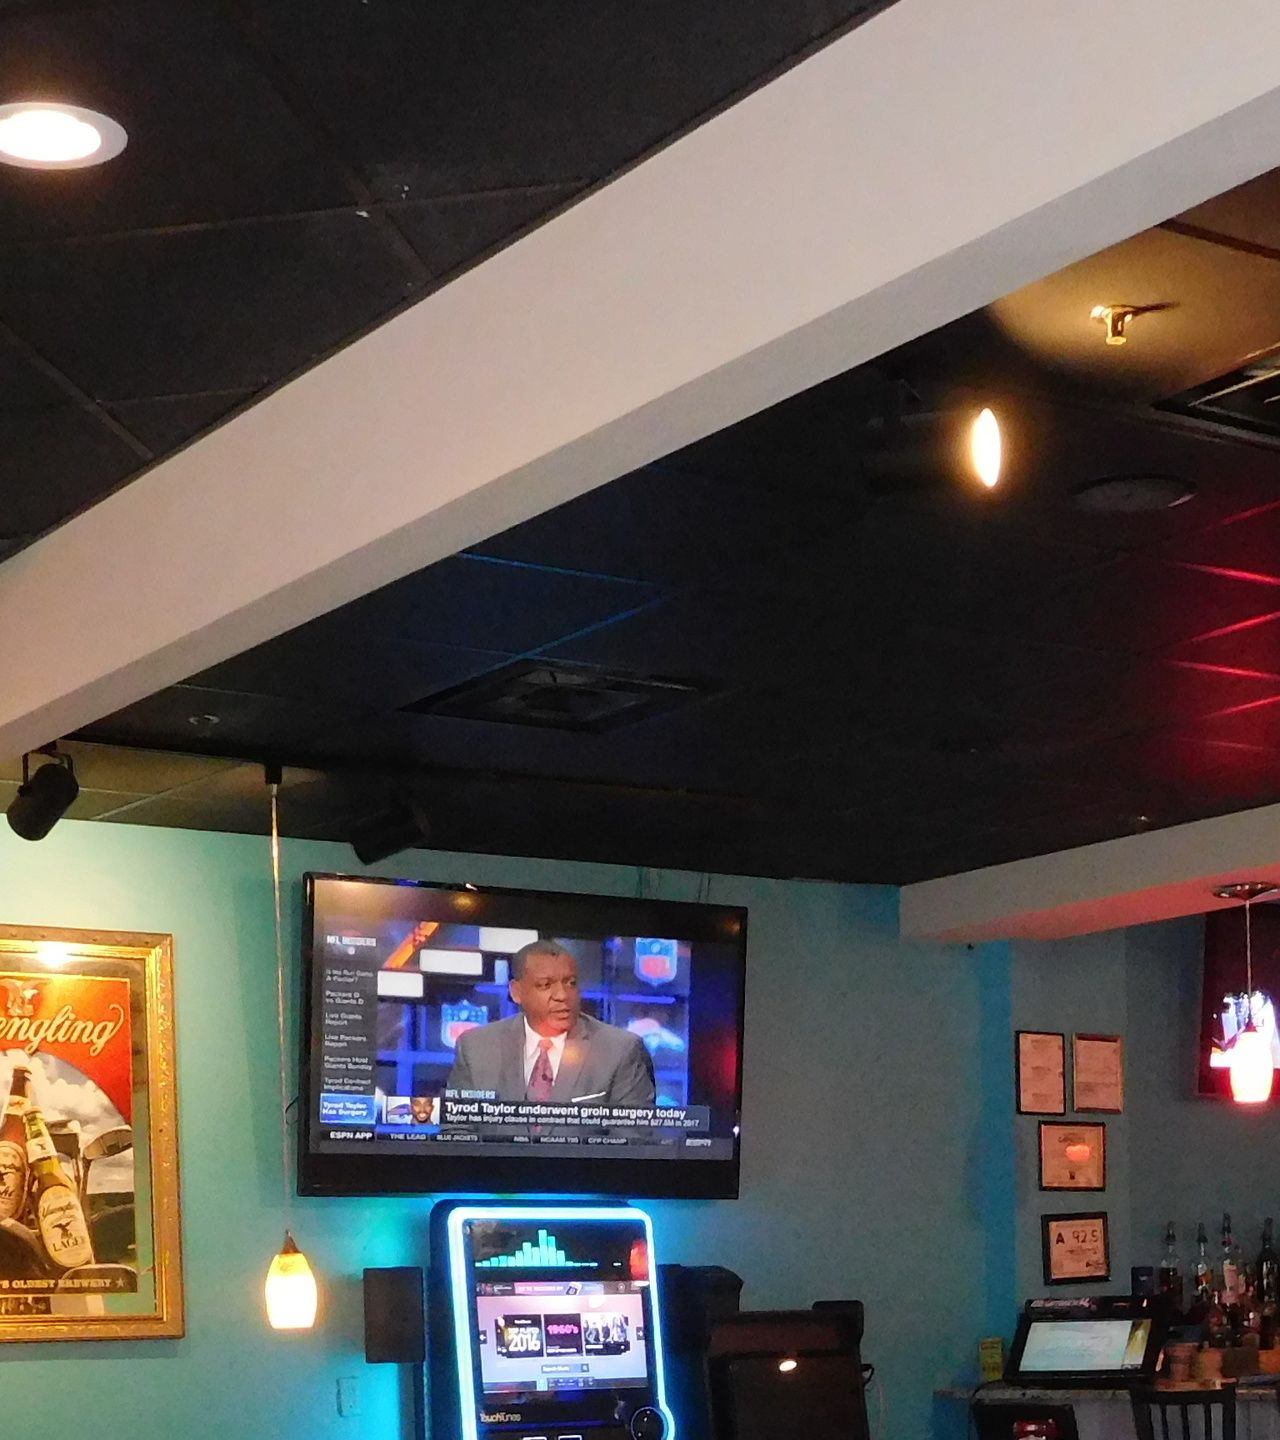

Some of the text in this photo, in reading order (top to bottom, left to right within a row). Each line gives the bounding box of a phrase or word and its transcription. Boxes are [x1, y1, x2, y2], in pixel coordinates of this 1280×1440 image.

[445, 1101, 686, 1120] Tyrod Taylor underwent groin surgery today
[445, 1113, 468, 1123] Taylor
[469, 1114, 482, 1122] has
[483, 1115, 503, 1124] injury
[330, 1131, 372, 1139] ESPN APP
[1056, 1232, 1065, 1245] A
[12, 1279, 55, 1289] OLDEST
[508, 1333, 540, 1352] 2016
